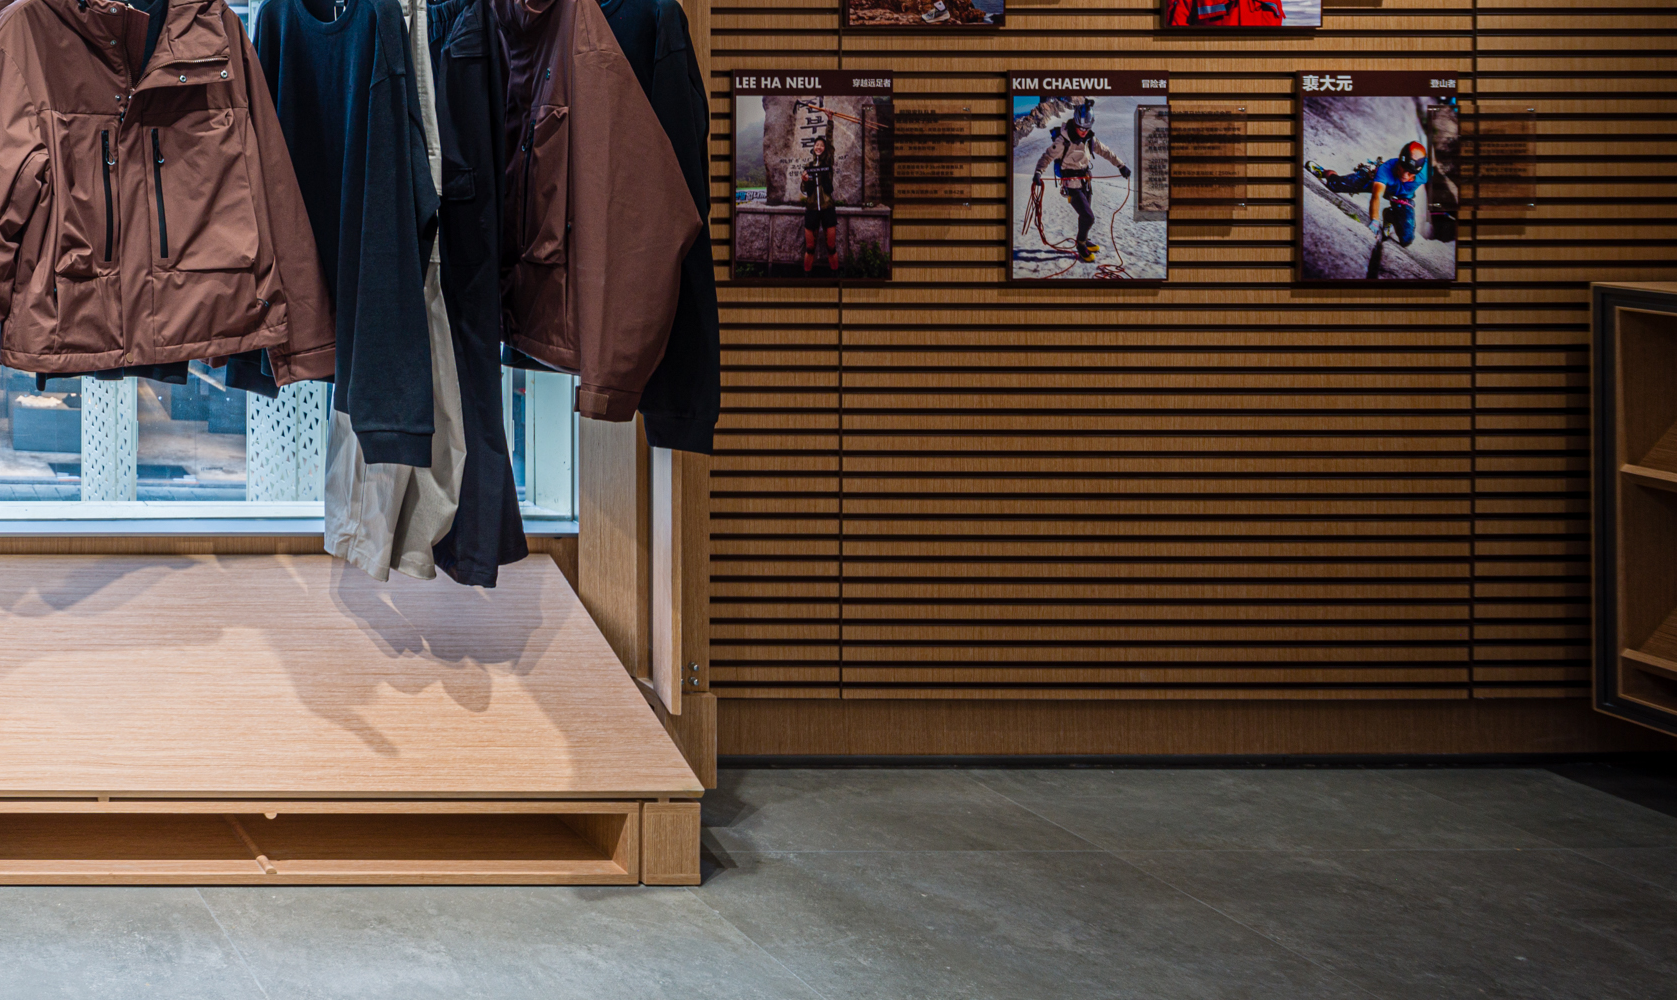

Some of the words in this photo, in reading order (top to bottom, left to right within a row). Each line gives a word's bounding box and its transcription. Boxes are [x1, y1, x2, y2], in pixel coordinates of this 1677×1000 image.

[735, 76, 757, 89] LEE
[761, 76, 782, 89] HA
[786, 76, 822, 89] NEUL
[852, 78, 891, 88] 穿越远足者
[1012, 77, 1039, 90] KIM
[1042, 77, 1112, 90] CHAEWUL
[1141, 79, 1167, 89] 冒险者
[1430, 78, 1457, 89] 登山者
